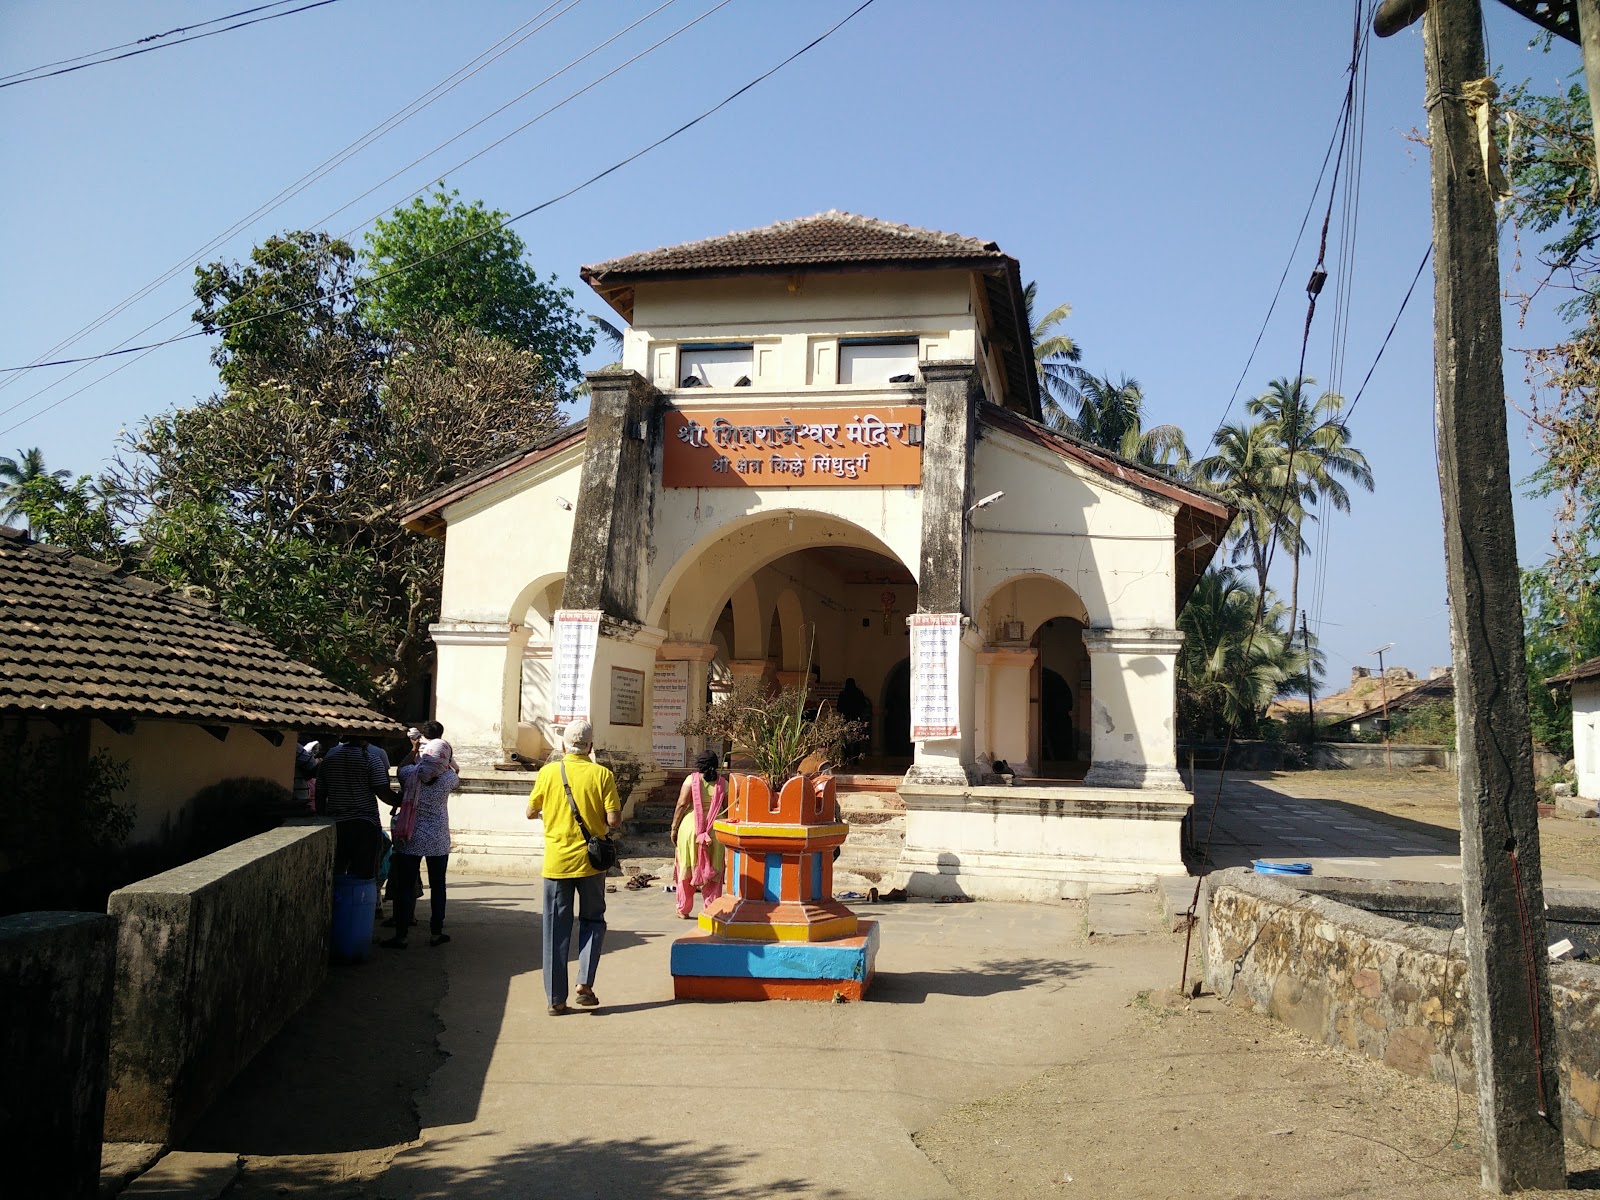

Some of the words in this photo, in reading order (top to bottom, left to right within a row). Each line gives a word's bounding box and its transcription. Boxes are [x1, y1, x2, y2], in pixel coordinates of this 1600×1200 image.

[677, 419, 709, 448] श्री
[712, 417, 844, 449] शिवराजेश्वर
[846, 414, 910, 447] मंदिर
[711, 454, 730, 473] श्री
[736, 454, 764, 473] क्षेत्र
[770, 453, 804, 476] किल्ले
[812, 452, 868, 478] सिंधुदुर्ग
